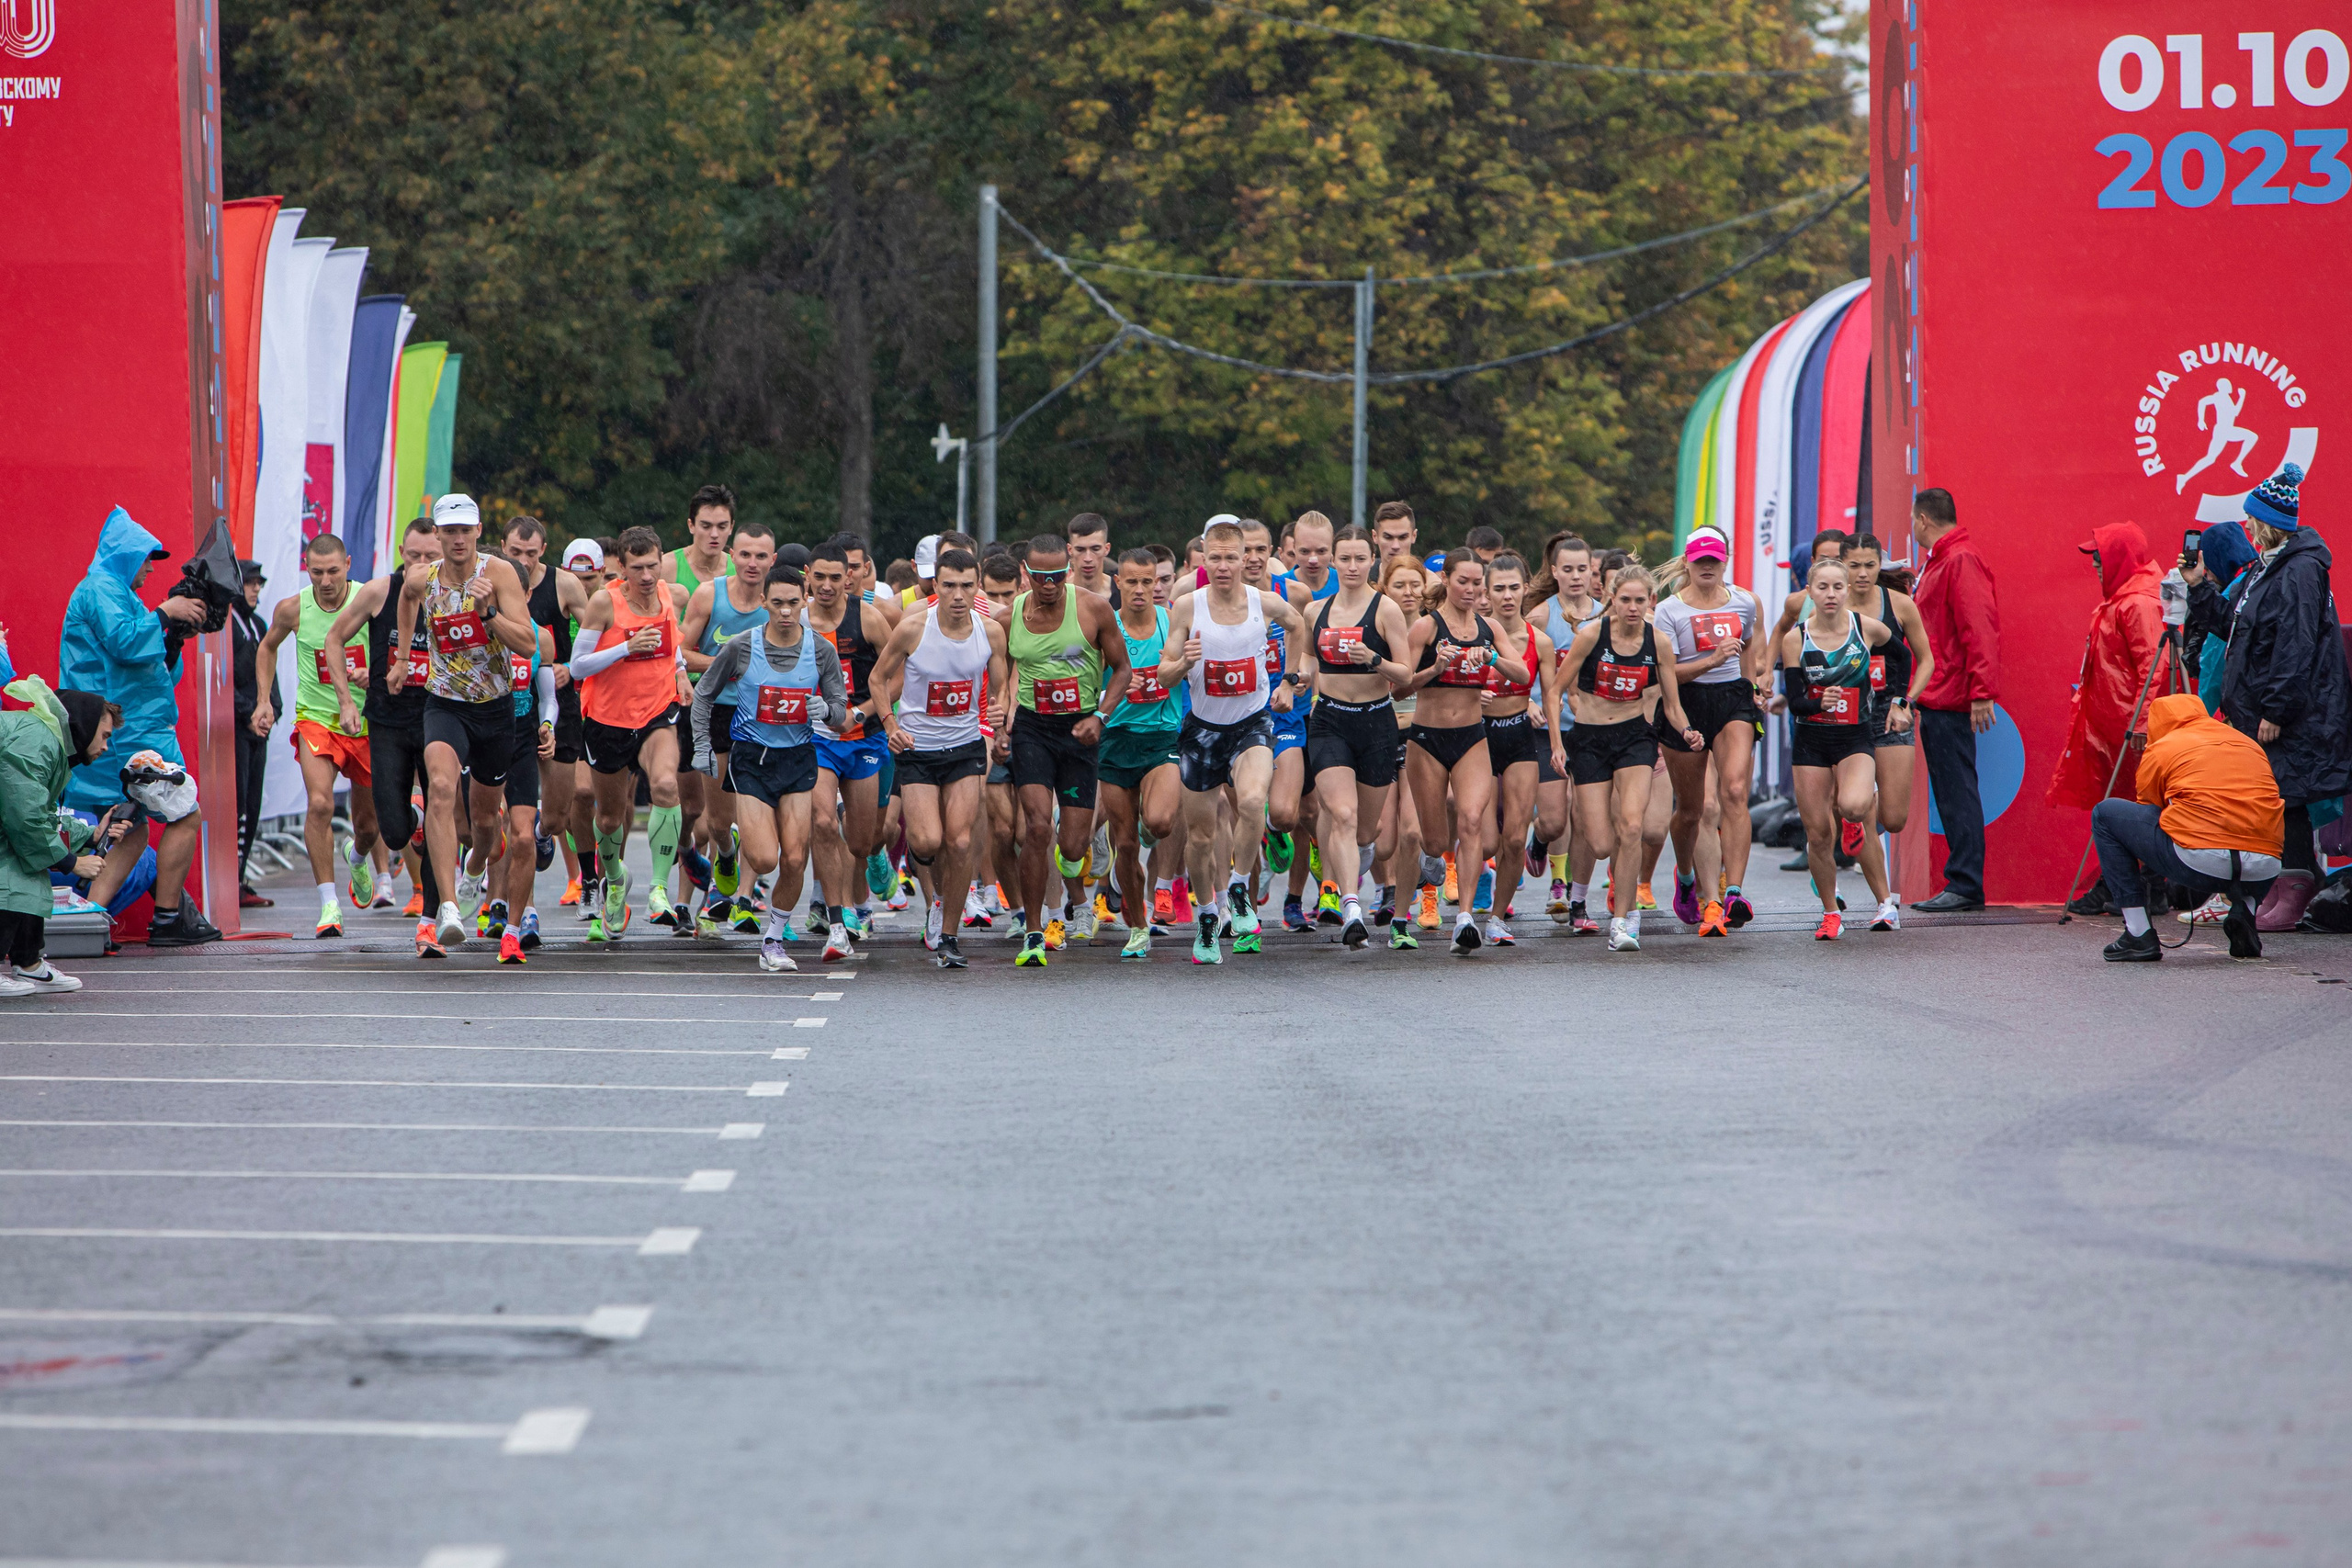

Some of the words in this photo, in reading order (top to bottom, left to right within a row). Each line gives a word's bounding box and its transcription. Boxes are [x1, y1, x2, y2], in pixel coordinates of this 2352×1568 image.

[2098, 28, 2350, 112] 01.10
[0, 77, 62, 99] СКОМУ
[2094, 129, 2352, 209] 2023
[2134, 369, 2180, 477] RUSSIA
[2178, 342, 2306, 408] RUNNING
[1760, 490, 1778, 557] RUSSI
[449, 624, 473, 640] 09
[1713, 623, 1732, 637] 61
[346, 657, 356, 670] 5
[1266, 650, 1277, 662] 4
[1460, 660, 1479, 674] 5
[1870, 667, 1883, 682] 4
[842, 671, 849, 684] 2
[1146, 678, 1164, 692] 2
[1225, 671, 1245, 686] 01
[1613, 677, 1637, 692] 53
[946, 691, 969, 706] 03
[1052, 688, 1077, 704] 05
[776, 699, 800, 714] 27
[1333, 704, 1363, 712] DEMIX
[1490, 715, 1522, 728] NIKE
